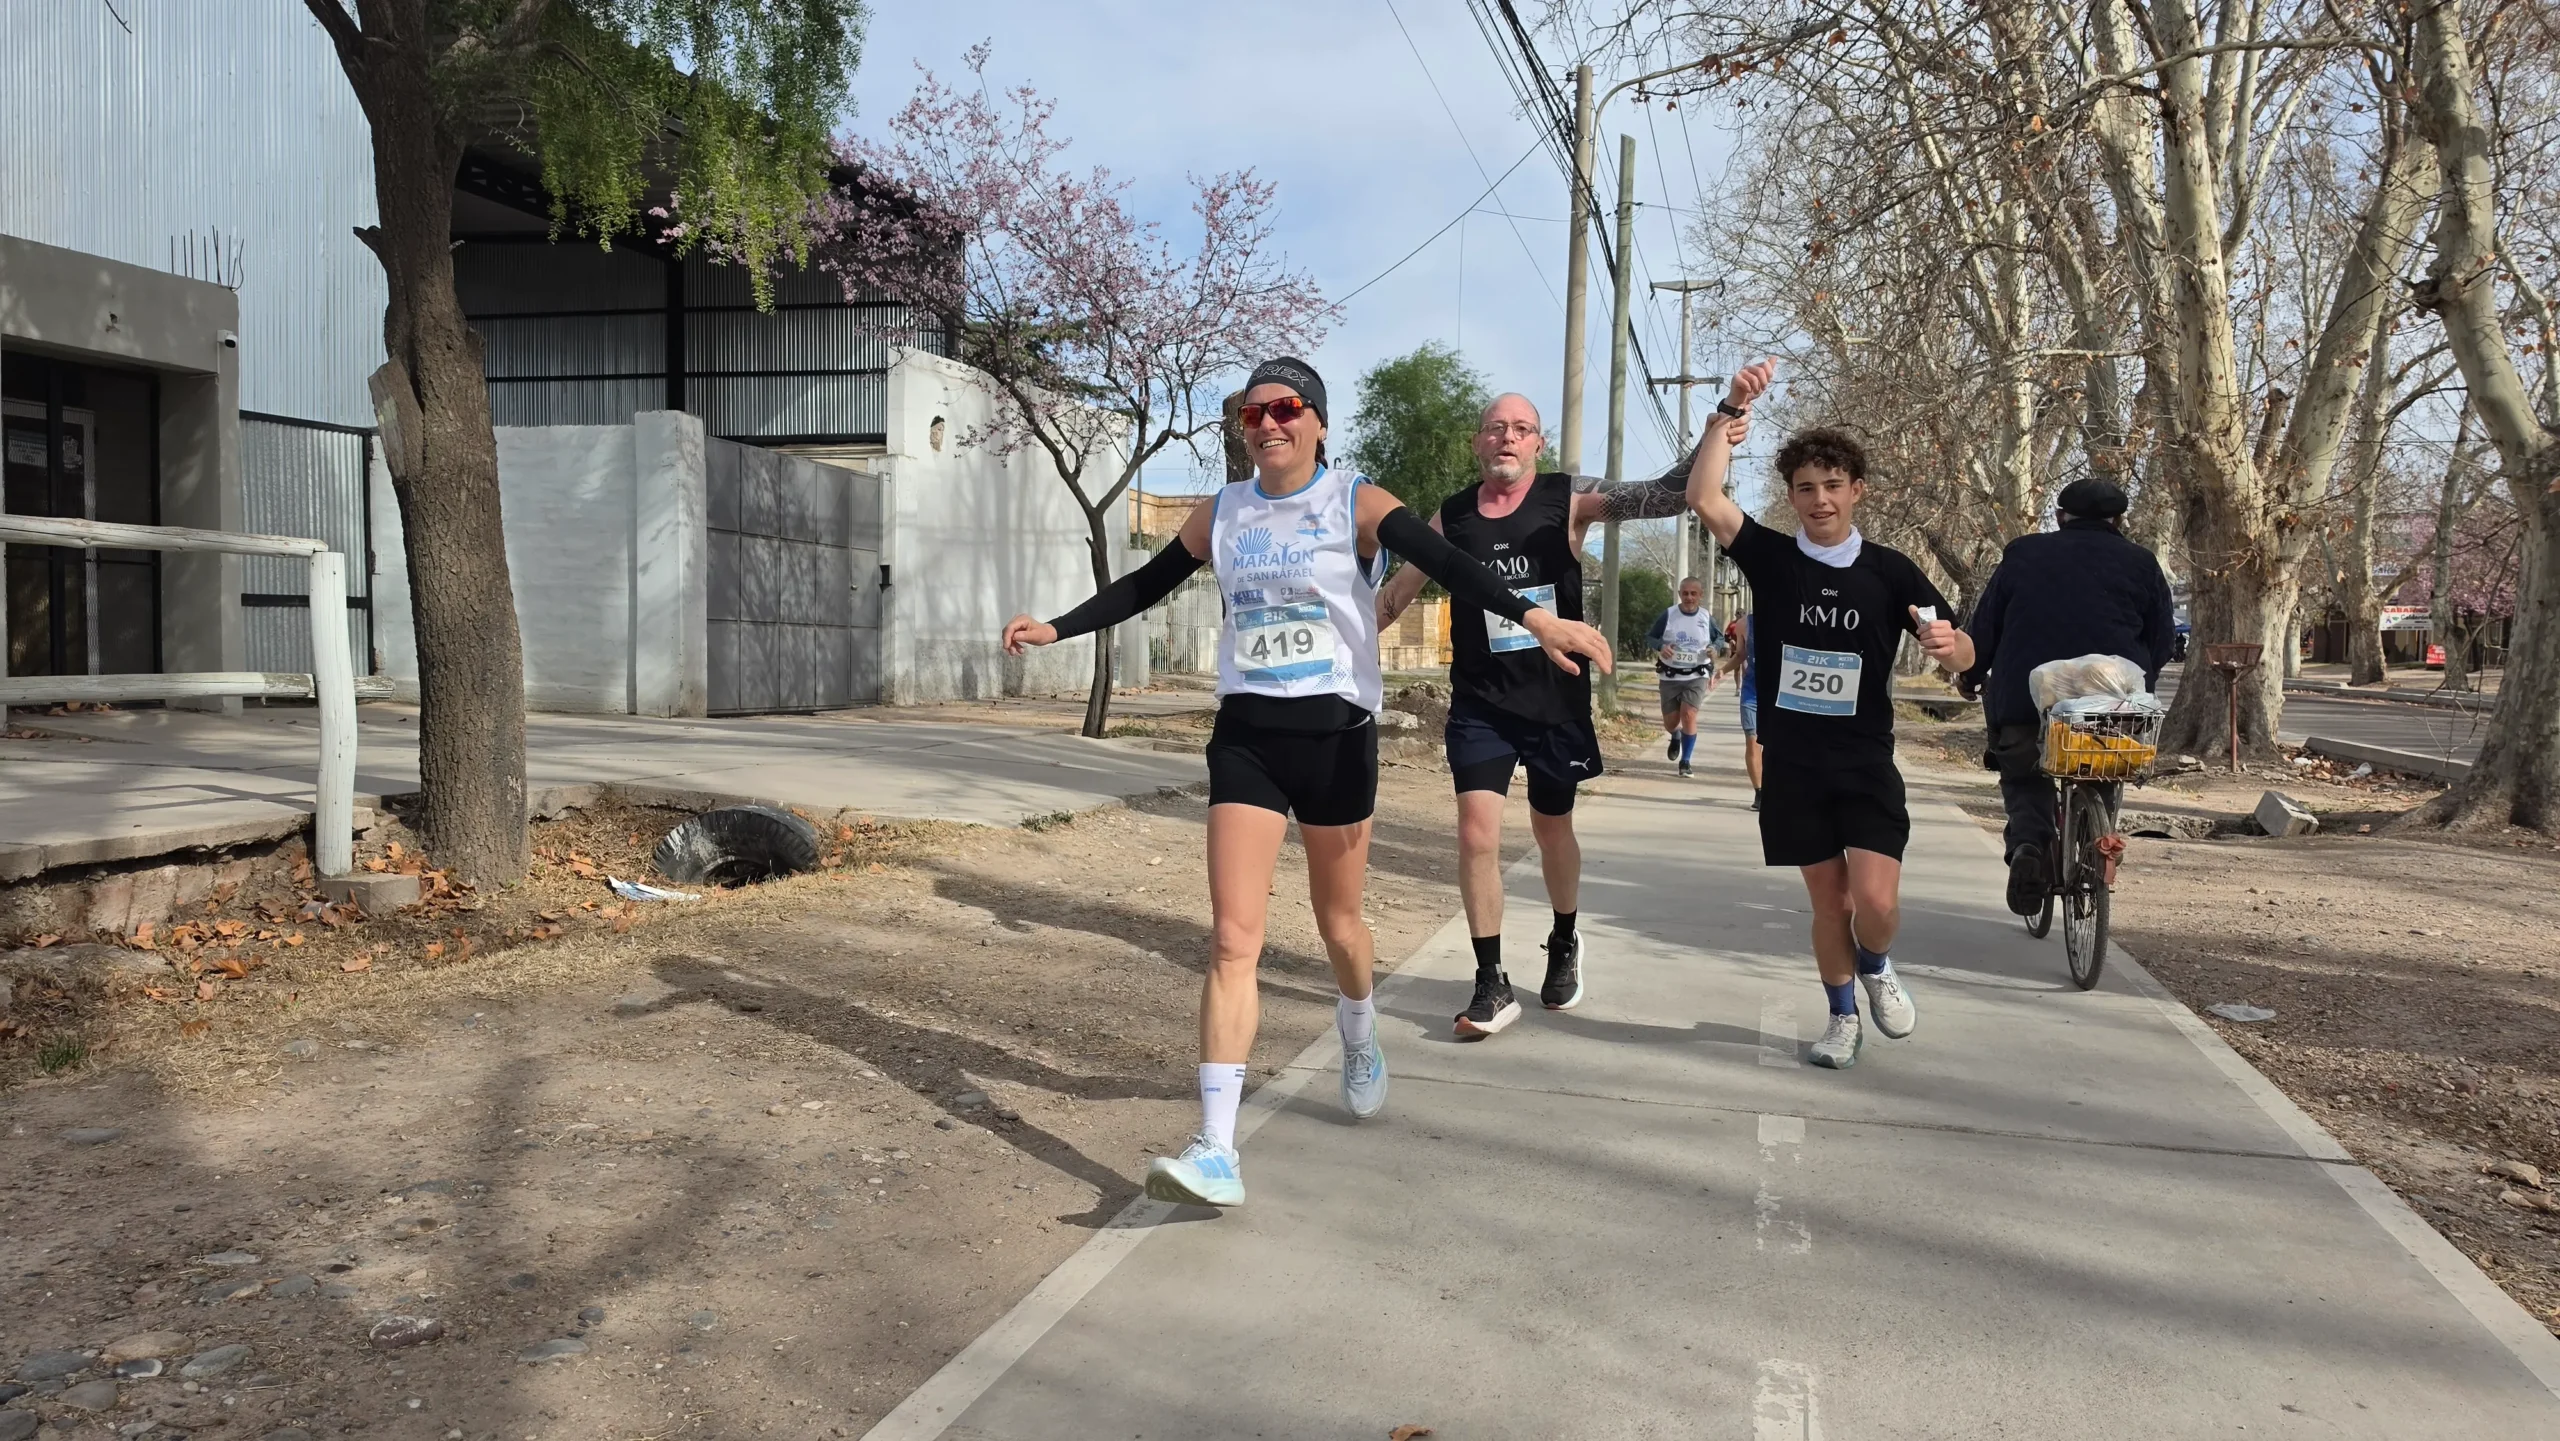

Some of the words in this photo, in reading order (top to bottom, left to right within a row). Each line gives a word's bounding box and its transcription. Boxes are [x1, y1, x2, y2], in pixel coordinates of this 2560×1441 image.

[1237, 576, 1245, 584] DE
[1246, 571, 1269, 582] SAN
[1271, 567, 1315, 580] RAFAEL
[1263, 610, 1289, 623] 21K
[1250, 628, 1314, 660] 419
[1676, 653, 1693, 662] 378
[1806, 654, 1831, 666] 21K
[1791, 669, 1844, 695] 250
